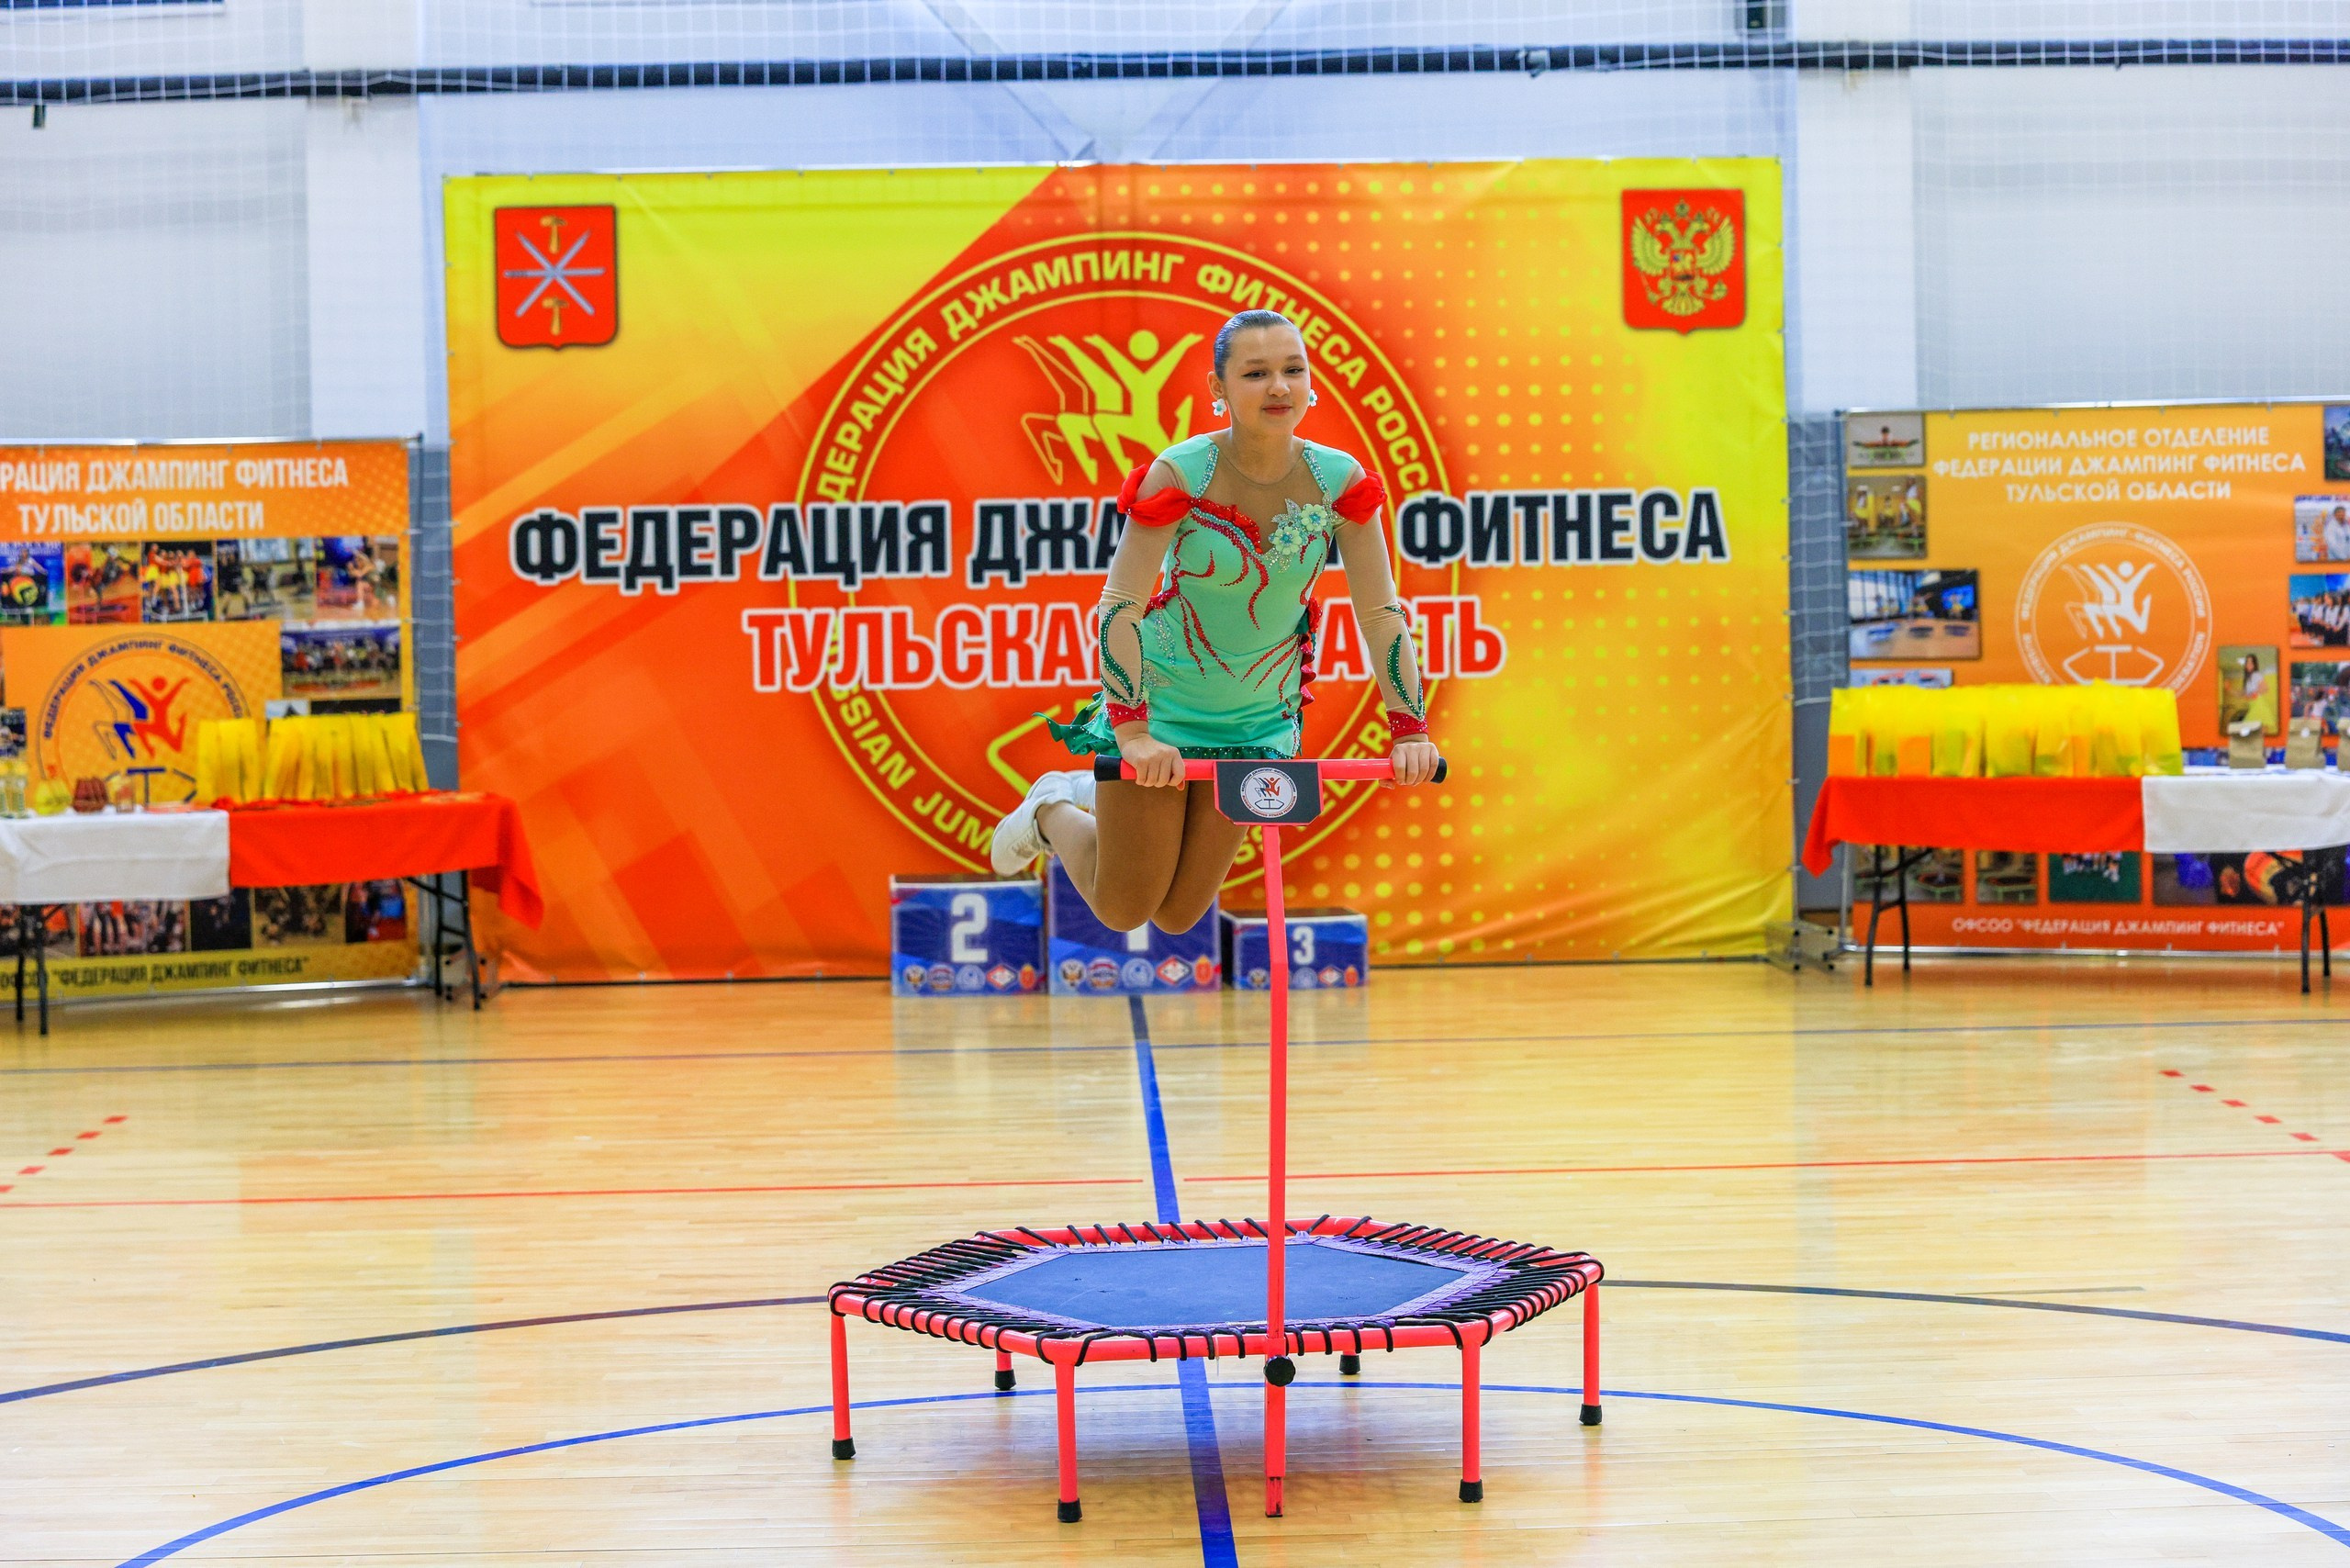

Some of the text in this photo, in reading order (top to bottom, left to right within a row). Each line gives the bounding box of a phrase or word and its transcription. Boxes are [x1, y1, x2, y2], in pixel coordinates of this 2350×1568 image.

[816, 250, 1429, 503] ДЕРАЦИЯ ДЖАМПИНГ ФИТНЕСА РОСС
[1967, 426, 2269, 451] РЕГИОНАЛЬНОЕ ОТДЕЛЕНИЕ
[0, 458, 349, 494] РАЦИЯ ДЖАМПИНГ ФИТНЕСА
[1932, 453, 2306, 479] ФЕДЕРАЦИИ ДЖАМПИНГ ФИТНЕСА
[2006, 478, 2231, 503] ТУЛЬСКОЙ ОБЛАСТИ
[17, 498, 264, 534] ТУЛЬСКОЙ ОБЛАСТИ
[511, 503, 949, 592] ФЕДЕРАЦИЯ
[1399, 489, 1729, 567] ФИТНЕСА
[744, 602, 1100, 693] ТУЛЬСКА
[952, 893, 988, 962] 2
[1292, 925, 1315, 965] 3
[2113, 920, 2203, 935] ДЖАМПИНГ
[2207, 920, 2285, 936] ФИТНЕСА"
[151, 961, 231, 982] ДЖАМПИНГ
